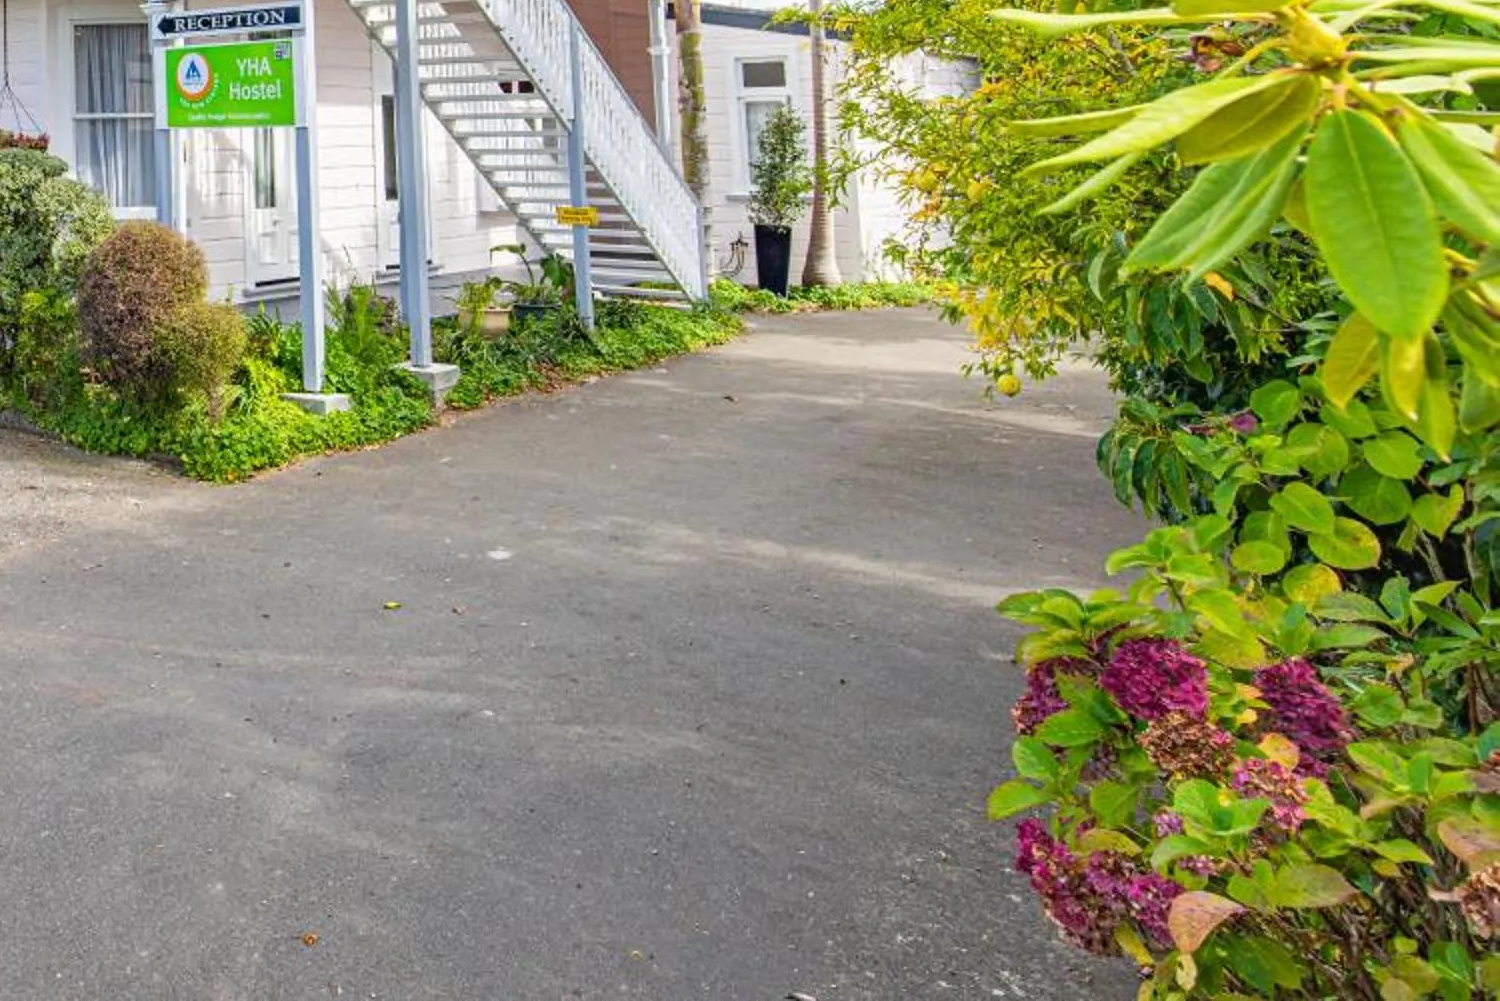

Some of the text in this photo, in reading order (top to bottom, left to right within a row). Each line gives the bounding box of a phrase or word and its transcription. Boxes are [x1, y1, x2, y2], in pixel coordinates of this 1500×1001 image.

[173, 9, 286, 32] RECEPTION
[236, 56, 272, 78] YHA
[229, 78, 282, 100] Hostel
